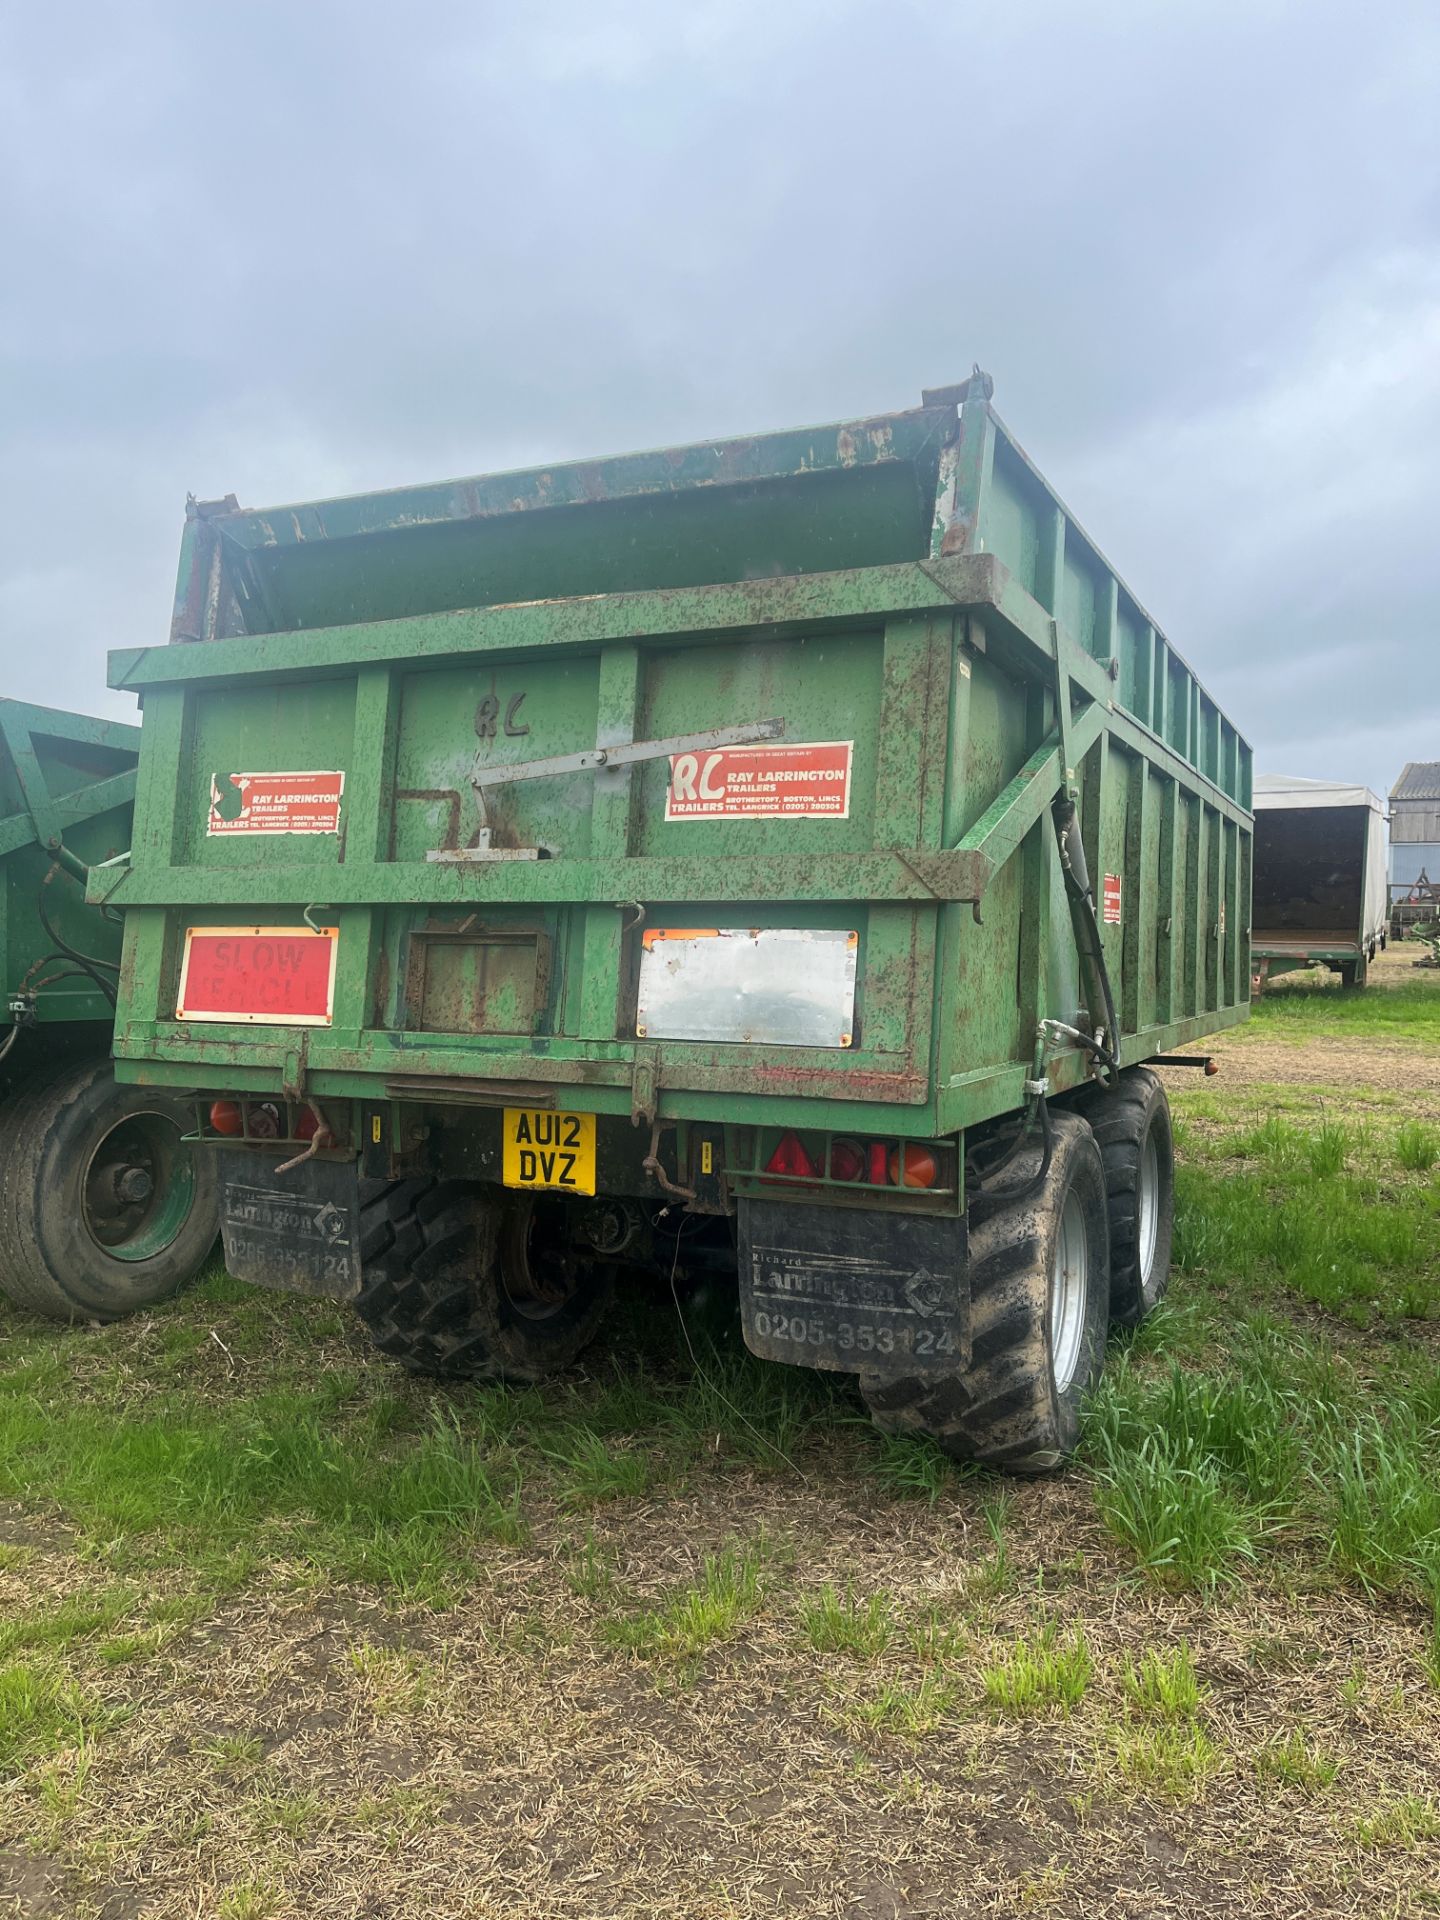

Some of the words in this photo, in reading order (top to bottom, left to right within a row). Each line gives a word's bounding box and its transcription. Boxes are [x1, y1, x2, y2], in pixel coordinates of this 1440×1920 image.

[475, 688, 530, 737] RC
[673, 754, 726, 801] RC
[727, 773, 755, 783] RAY
[758, 770, 845, 782] LARRINGTON
[252, 795, 272, 804] RAY
[274, 793, 338, 804] LARRINGTON
[727, 784, 776, 793] TRAILERS
[252, 805, 288, 813] TRAILERS
[672, 803, 724, 812] TRAILERS
[212, 821, 249, 829] TRAILERS
[214, 942, 306, 974] SLOW
[516, 1113, 581, 1148] AU12
[520, 1150, 576, 1185] DVZ
[752, 1252, 801, 1266] Richard
[752, 1264, 895, 1302] Larrington
[754, 1311, 955, 1355] 0205-353124
